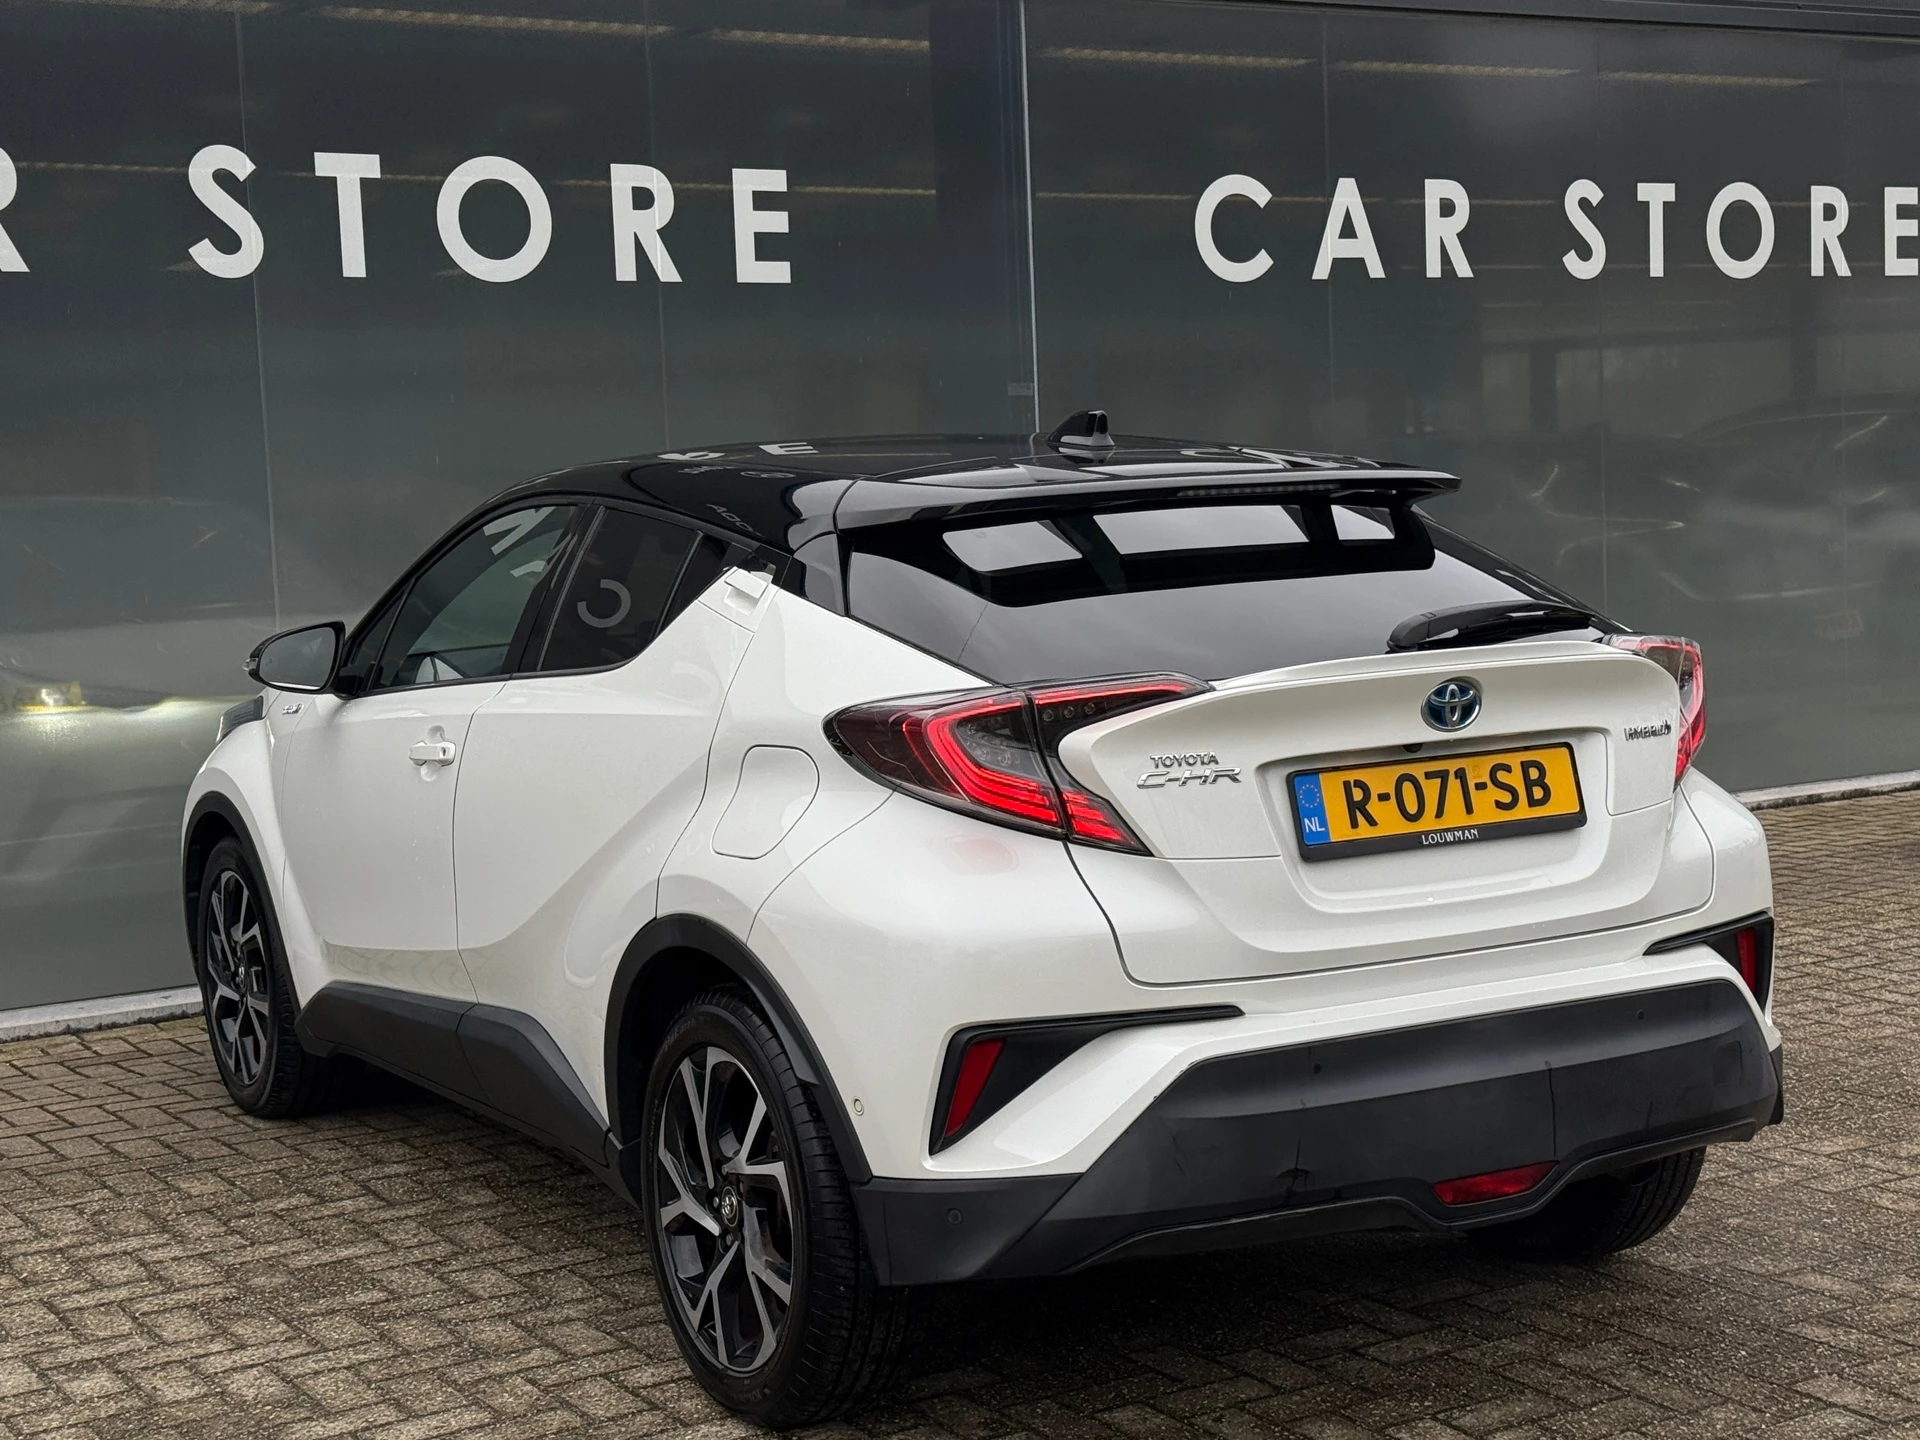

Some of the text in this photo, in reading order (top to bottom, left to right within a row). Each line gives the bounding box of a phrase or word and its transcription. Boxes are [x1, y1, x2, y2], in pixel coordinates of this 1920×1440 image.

[188, 144, 792, 284] STORE
[1194, 174, 1920, 283] CAR STORE
[1149, 751, 1219, 769] TOYOTA
[1136, 767, 1242, 789] C-HR
[1342, 759, 1552, 830] R-071-SB
[1304, 816, 1326, 834] NL
[1421, 828, 1479, 845] LOUWMAN
